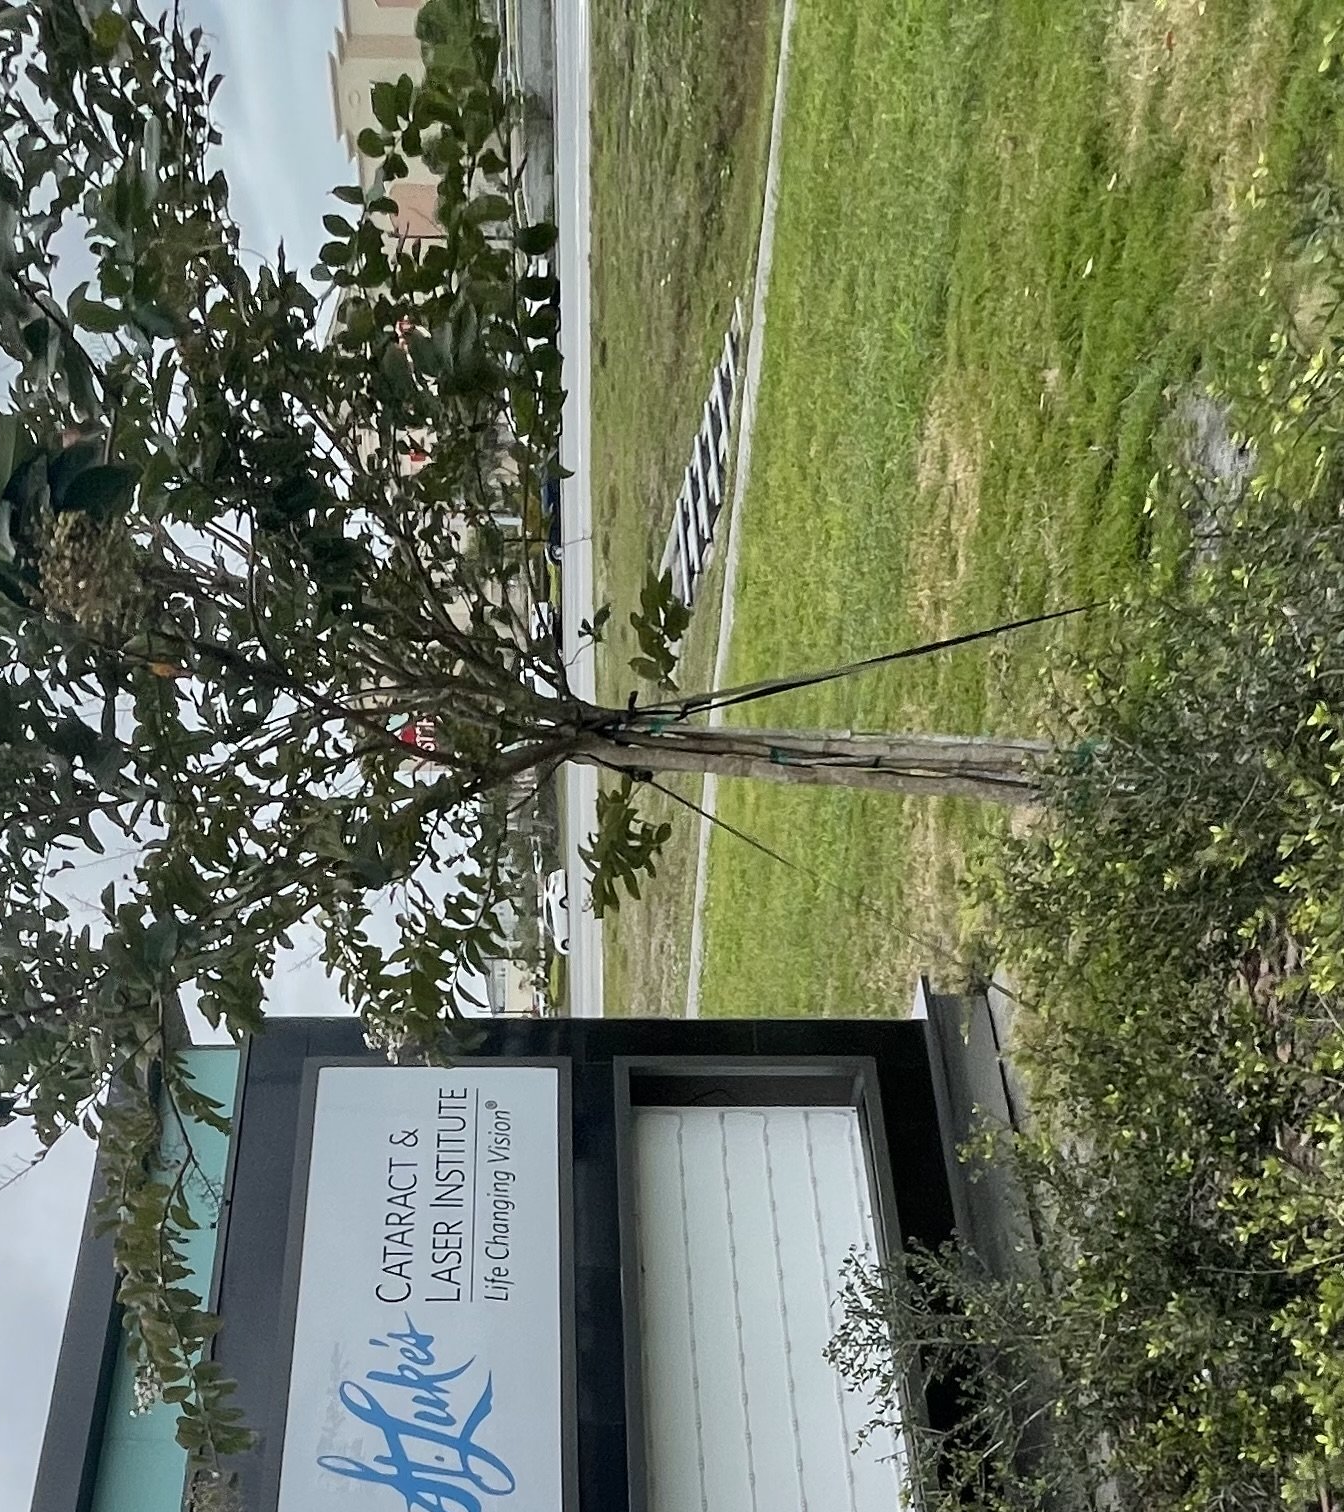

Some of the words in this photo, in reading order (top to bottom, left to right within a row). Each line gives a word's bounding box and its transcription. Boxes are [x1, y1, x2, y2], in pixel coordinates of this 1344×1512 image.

[388, 1128, 419, 1148] &
[429, 1087, 468, 1208] INSTITUTE
[374, 1157, 419, 1304] CATARACT
[483, 1170, 516, 1260] Changing
[424, 1220, 463, 1303] LASER
[483, 1266, 515, 1302] Life
[339, 1311, 516, 1495] Luke's
